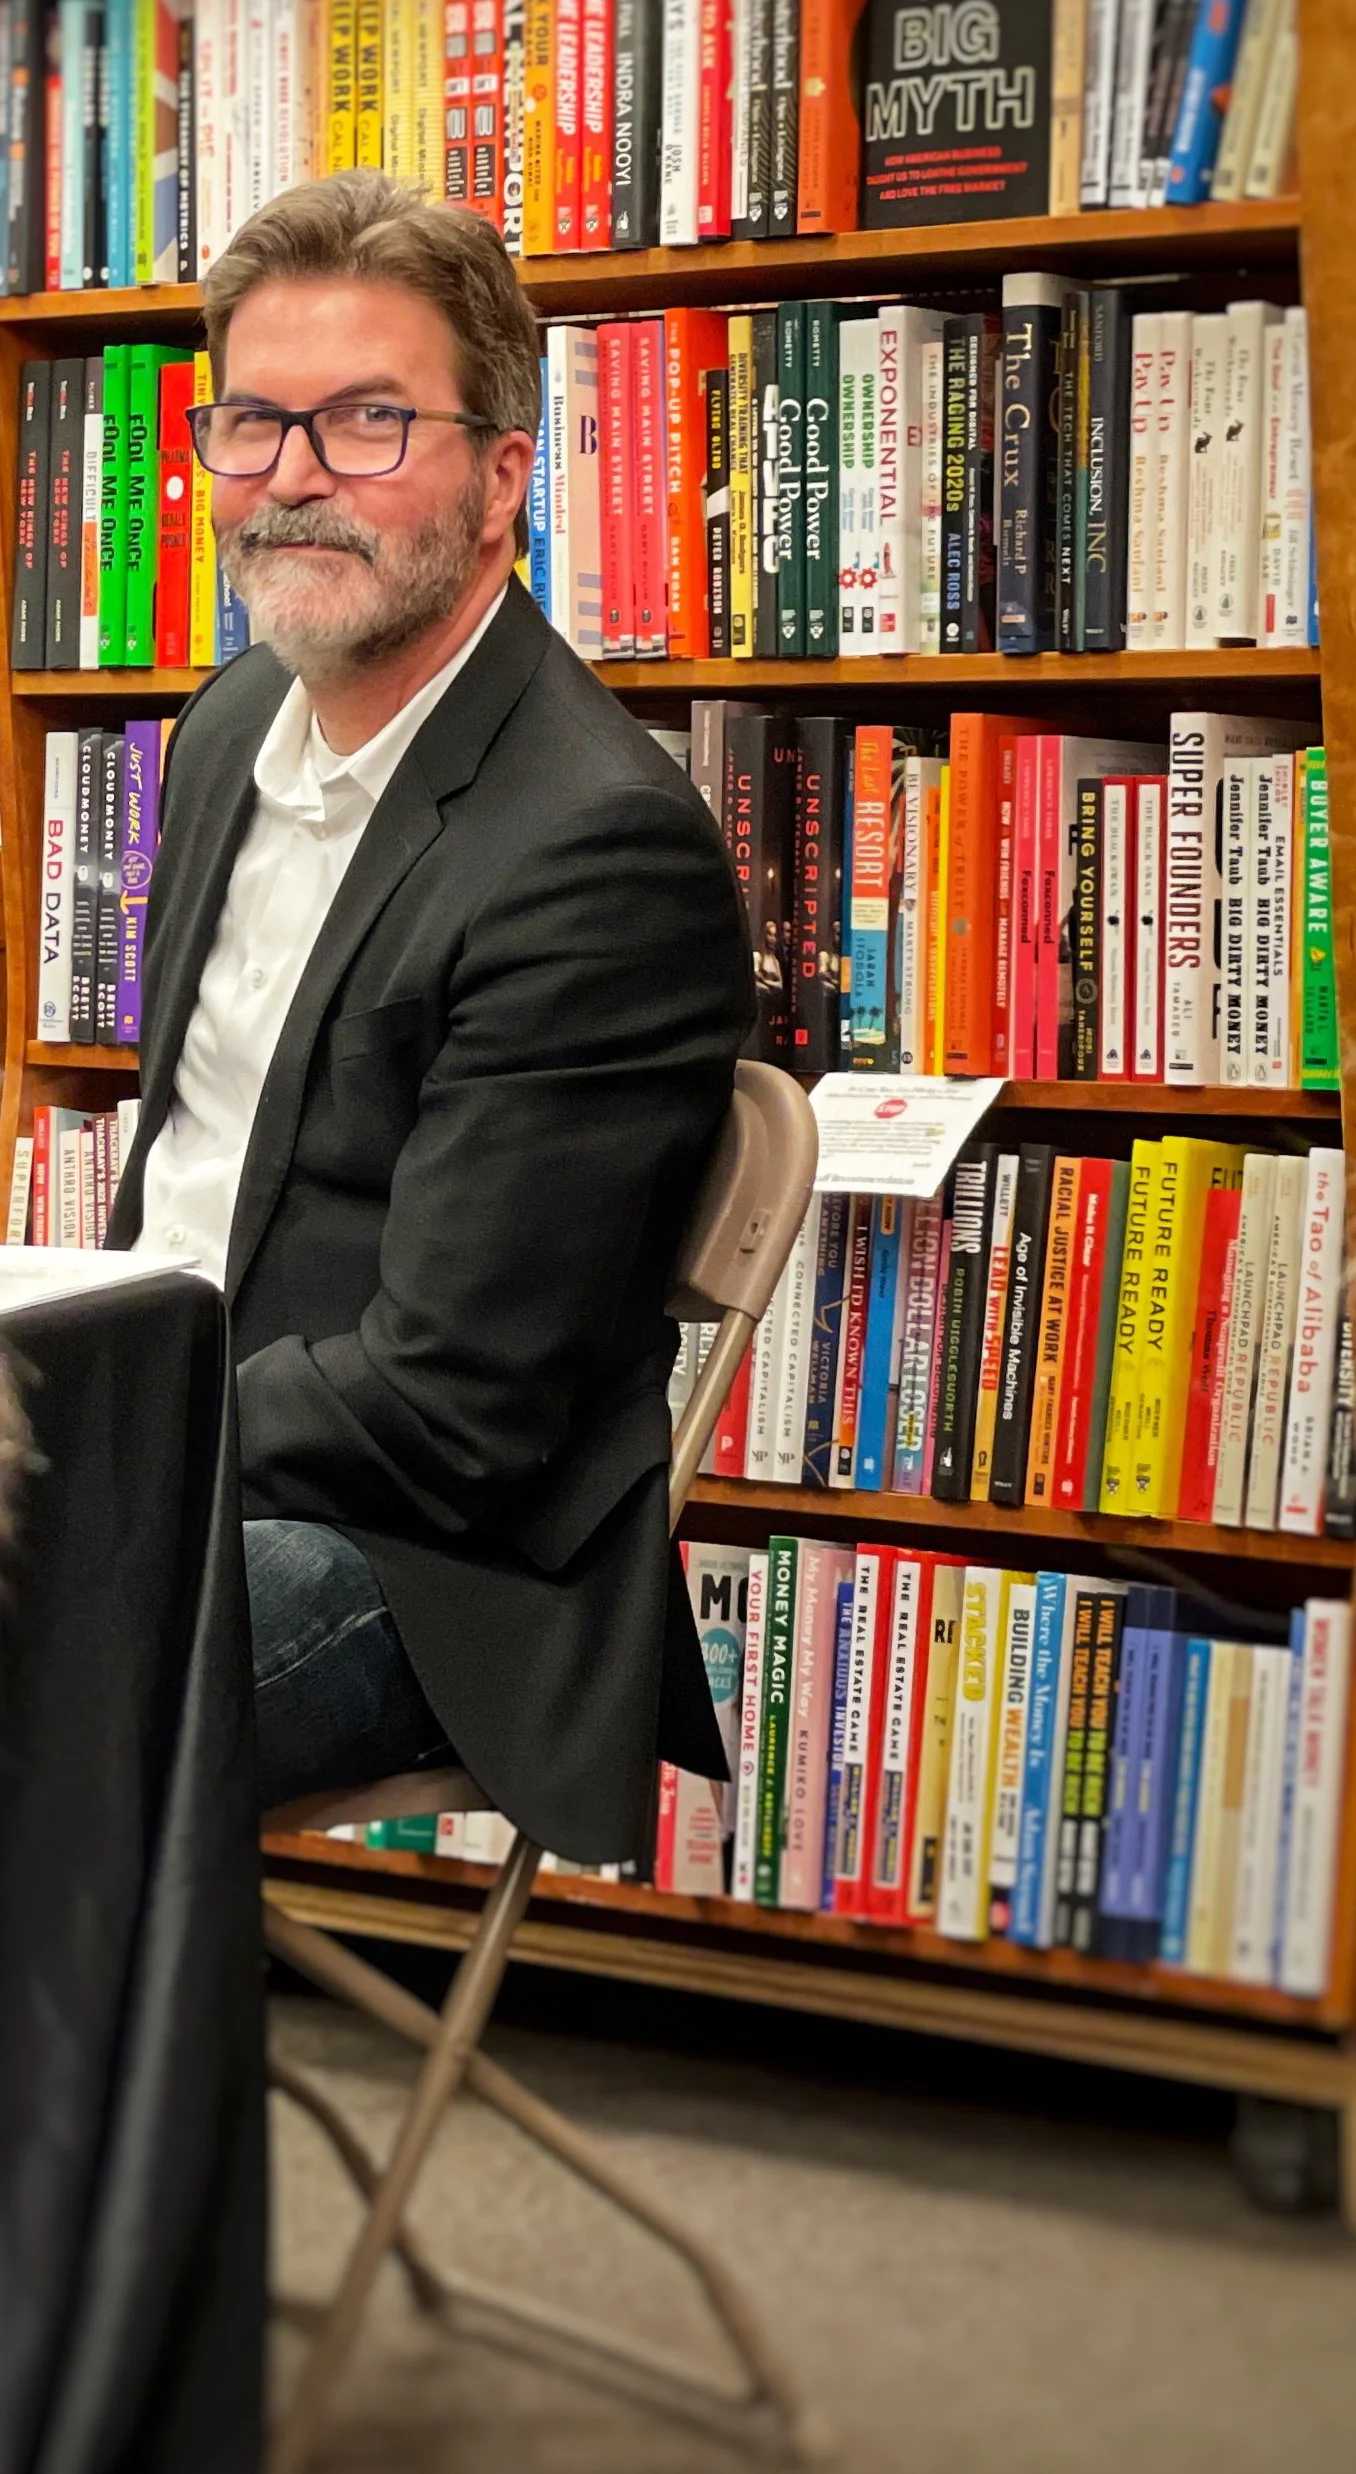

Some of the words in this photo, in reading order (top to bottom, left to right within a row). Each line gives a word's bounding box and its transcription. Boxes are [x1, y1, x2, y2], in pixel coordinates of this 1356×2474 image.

[535, 14, 551, 67] YOUR
[893, 0, 1001, 72] BIG
[333, 45, 352, 113] WORK
[583, 20, 606, 133] LEADERSHIP
[615, 51, 634, 117] INDRA
[866, 66, 1036, 142] MYTH
[614, 121, 633, 187] NOOYI
[671, 143, 682, 173] JOSH
[897, 187, 920, 199] LOVE
[920, 185, 938, 197] THE
[938, 182, 963, 195] FREE
[179, 191, 190, 250] METRICS
[784, 319, 793, 367] ROMETTY
[811, 319, 821, 367] ROMETTY
[948, 338, 967, 371] THE
[968, 335, 978, 387] DESIGNED
[1005, 322, 1034, 391] The
[195, 374, 207, 406] TINY
[738, 352, 748, 402] DIVERSITY
[968, 388, 978, 410] FOR
[1064, 371, 1074, 398] THE
[553, 395, 566, 471] Business
[712, 389, 722, 430] FLYING
[738, 403, 749, 450] TRAINING
[780, 398, 802, 473] Good
[807, 398, 830, 473] Good
[842, 374, 855, 469] OWNERSHIP
[861, 373, 875, 468] OWNERSHIP
[880, 330, 898, 527] EXPONENTIAL
[947, 377, 966, 449] RAGING
[967, 410, 978, 452] DIGITAL
[1063, 405, 1074, 442] TECH
[102, 413, 120, 465] FOOL
[712, 435, 722, 470] BLIND
[739, 451, 749, 475] THAT
[1003, 403, 1032, 487] Crux
[84, 451, 97, 522] DIFFICULT
[101, 475, 118, 510] ME
[946, 453, 965, 512] 2020s
[1063, 449, 1073, 486] THAT
[195, 489, 206, 520] BIG
[554, 474, 566, 536] Minded
[777, 479, 801, 560] Power
[806, 479, 830, 560] Power
[1062, 492, 1073, 540] COMES
[99, 517, 116, 574] ONCE
[194, 523, 205, 565] MONEY
[712, 526, 722, 562] PETER
[947, 532, 962, 568] ALEC
[1014, 508, 1029, 561] Richard
[712, 567, 722, 615] ROBISON
[947, 571, 961, 610] ROSS
[1014, 562, 1028, 574] P
[1061, 546, 1072, 584] NEXT
[127, 741, 144, 788] JUST
[860, 740, 879, 770] The
[860, 765, 880, 798] Last
[1170, 732, 1206, 818] SUPER
[79, 744, 92, 854] CLOUDMONEY
[103, 751, 116, 860] CLOUDMONEY
[906, 773, 919, 793] BE
[1227, 774, 1245, 842] Jennifer
[127, 791, 142, 846] WORK
[999, 801, 1011, 826] HOW
[1080, 791, 1096, 857] BRING
[46, 819, 64, 881] BAD
[853, 800, 885, 889] RESORT
[904, 796, 920, 893] VISIONARY
[999, 838, 1011, 860] WIN
[1227, 846, 1244, 886] Taub
[1274, 835, 1287, 883] EMAIL
[801, 773, 820, 979] UNSCRIPTED
[997, 860, 1010, 900] FRIENDS
[1166, 831, 1205, 970] FOUNDERS
[43, 892, 62, 964] DATA
[124, 916, 138, 940] KIM
[997, 917, 1008, 958] MANAGE
[1079, 866, 1096, 971] YOURSELF
[1227, 897, 1244, 928] BIG
[1272, 887, 1286, 977] ESSENTIALS
[122, 943, 137, 983] SCOTT
[853, 937, 866, 998] STODOLA
[865, 945, 877, 989] SARAH
[905, 920, 915, 962] MARTY
[1227, 933, 1243, 988] DIRTY
[72, 974, 81, 1022] SCOTT
[81, 975, 91, 1021] BRETT
[105, 983, 116, 1028] BRETT
[903, 965, 914, 1016] STRONG
[995, 959, 1007, 1008] REMOTELY
[1182, 999, 1192, 1020] ALI
[1226, 994, 1242, 1056] MONEY
[63, 1149, 76, 1194] ANTHRO
[1055, 1166, 1074, 1220] RACIAL
[63, 1200, 77, 1239] VISION
[857, 1225, 868, 1233] I
[951, 1160, 988, 1255] TRILLIONS
[1126, 1165, 1150, 1261] FUTURE
[1154, 1161, 1179, 1258] FUTURE
[853, 1233, 868, 1278] WISH
[1049, 1225, 1070, 1289] JUSTICE
[790, 1260, 805, 1347] CONNECTED
[851, 1283, 865, 1307] I'D
[951, 1267, 966, 1314] ROBIN
[1048, 1294, 1064, 1314] AT
[1117, 1270, 1142, 1355] READY
[1146, 1267, 1170, 1352] READY
[1238, 1259, 1256, 1348] LAUNCHPAD
[1270, 1262, 1289, 1350] LAUNCHPAD
[846, 1310, 863, 1381] KNOWN
[1042, 1317, 1062, 1363] WORK
[1201, 1307, 1217, 1360] Thomas
[818, 1340, 831, 1404] VICTORIA
[943, 1319, 962, 1433] WIGGLESWORTH
[1199, 1362, 1214, 1393] Wolf
[1336, 1321, 1354, 1408] DIVERSITY
[756, 1351, 772, 1435] CAPITALISM
[782, 1352, 798, 1439] CAPITALISM
[841, 1382, 857, 1426] THIS
[1228, 1351, 1249, 1442] REPUBLIC
[1261, 1353, 1282, 1445] REPUBLIC
[806, 1554, 822, 1582] My
[858, 1564, 871, 1594] THE
[747, 1570, 763, 1623] YOUR
[801, 1585, 820, 1646] Money
[840, 1600, 854, 1623] THE
[855, 1604, 869, 1641] REAL
[745, 1630, 761, 1687] FIRST
[799, 1648, 816, 1677] My
[835, 1627, 853, 1702] ANXIOUS
[962, 1581, 988, 1702] STACKED
[1006, 1608, 1031, 1704] BUILDING
[797, 1679, 814, 1719] Way
[851, 1647, 865, 1704] ESTATE
[742, 1694, 758, 1752] HOME
[831, 1704, 847, 1771] INVESTOR
[1002, 1707, 1024, 1787] WEALTH
[794, 1728, 810, 1798] KUMIKO
[791, 1807, 805, 1852] LOVE
